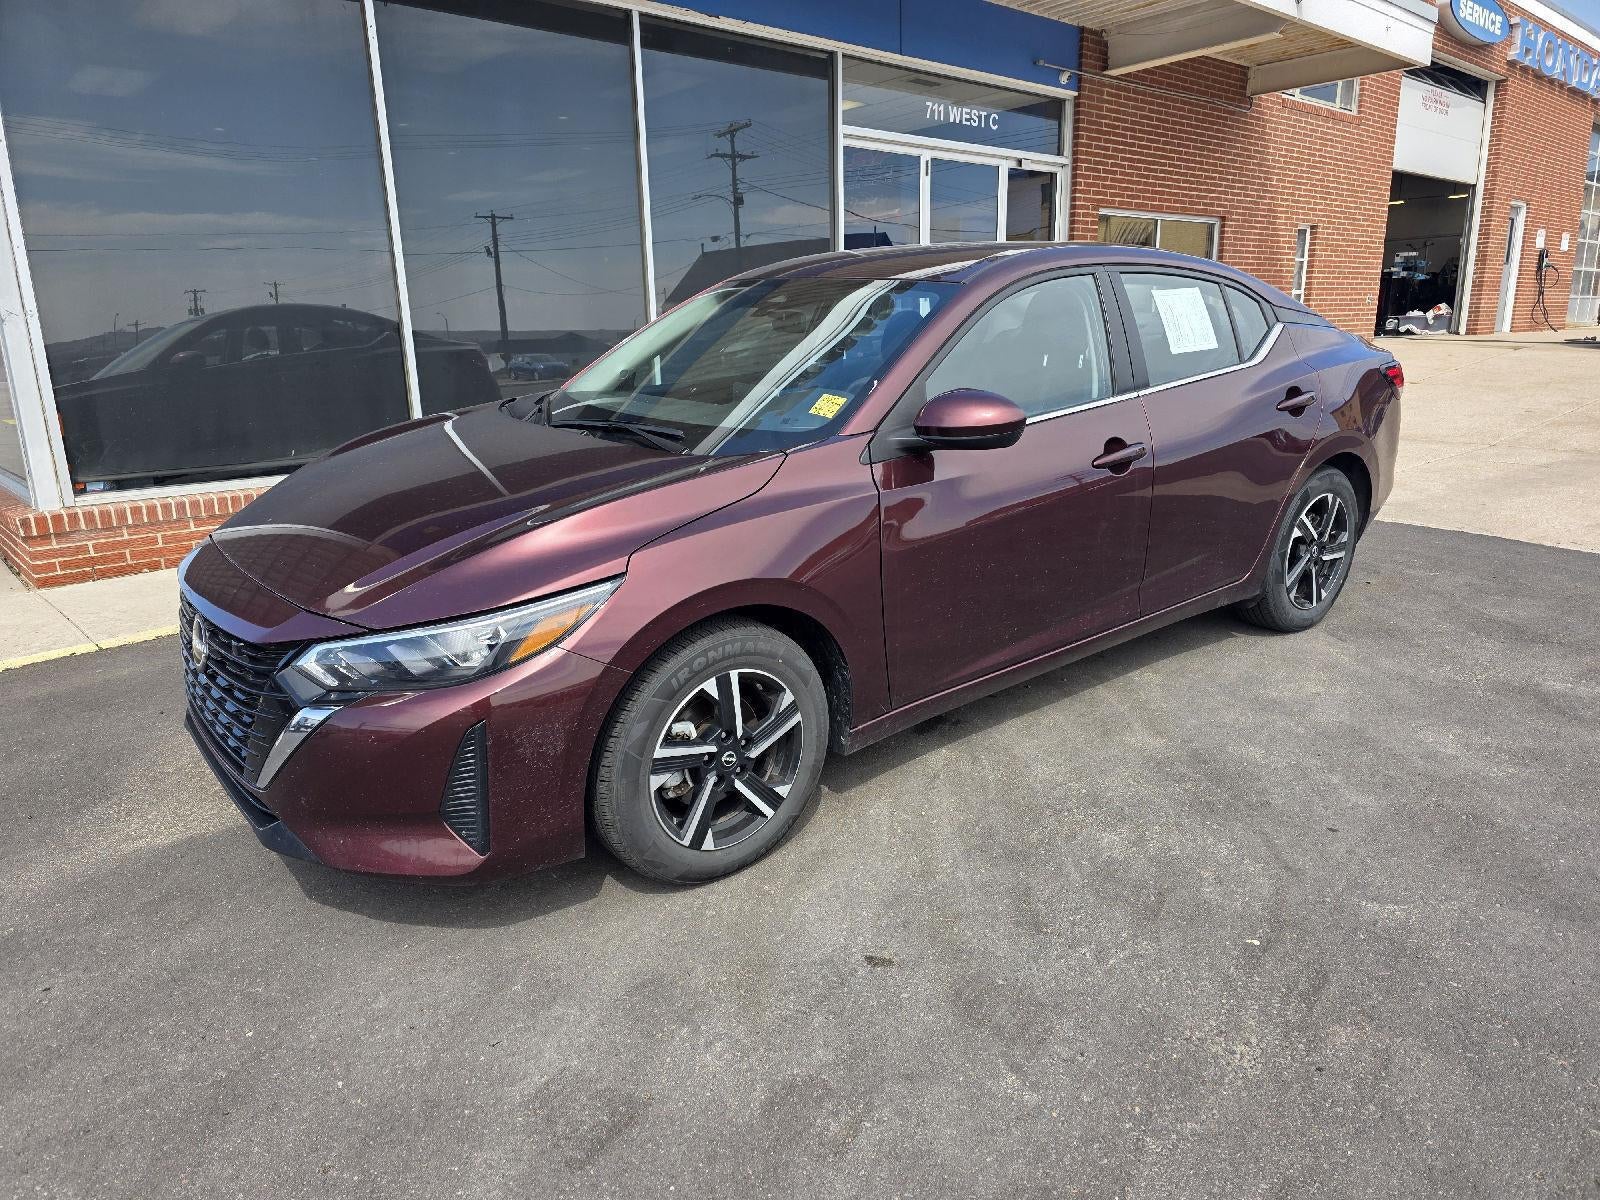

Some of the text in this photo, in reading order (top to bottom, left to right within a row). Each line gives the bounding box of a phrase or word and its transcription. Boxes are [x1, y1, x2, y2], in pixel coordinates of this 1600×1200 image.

[1459, 0, 1502, 35] SERVICE
[926, 101, 999, 130] 711 WEST C
